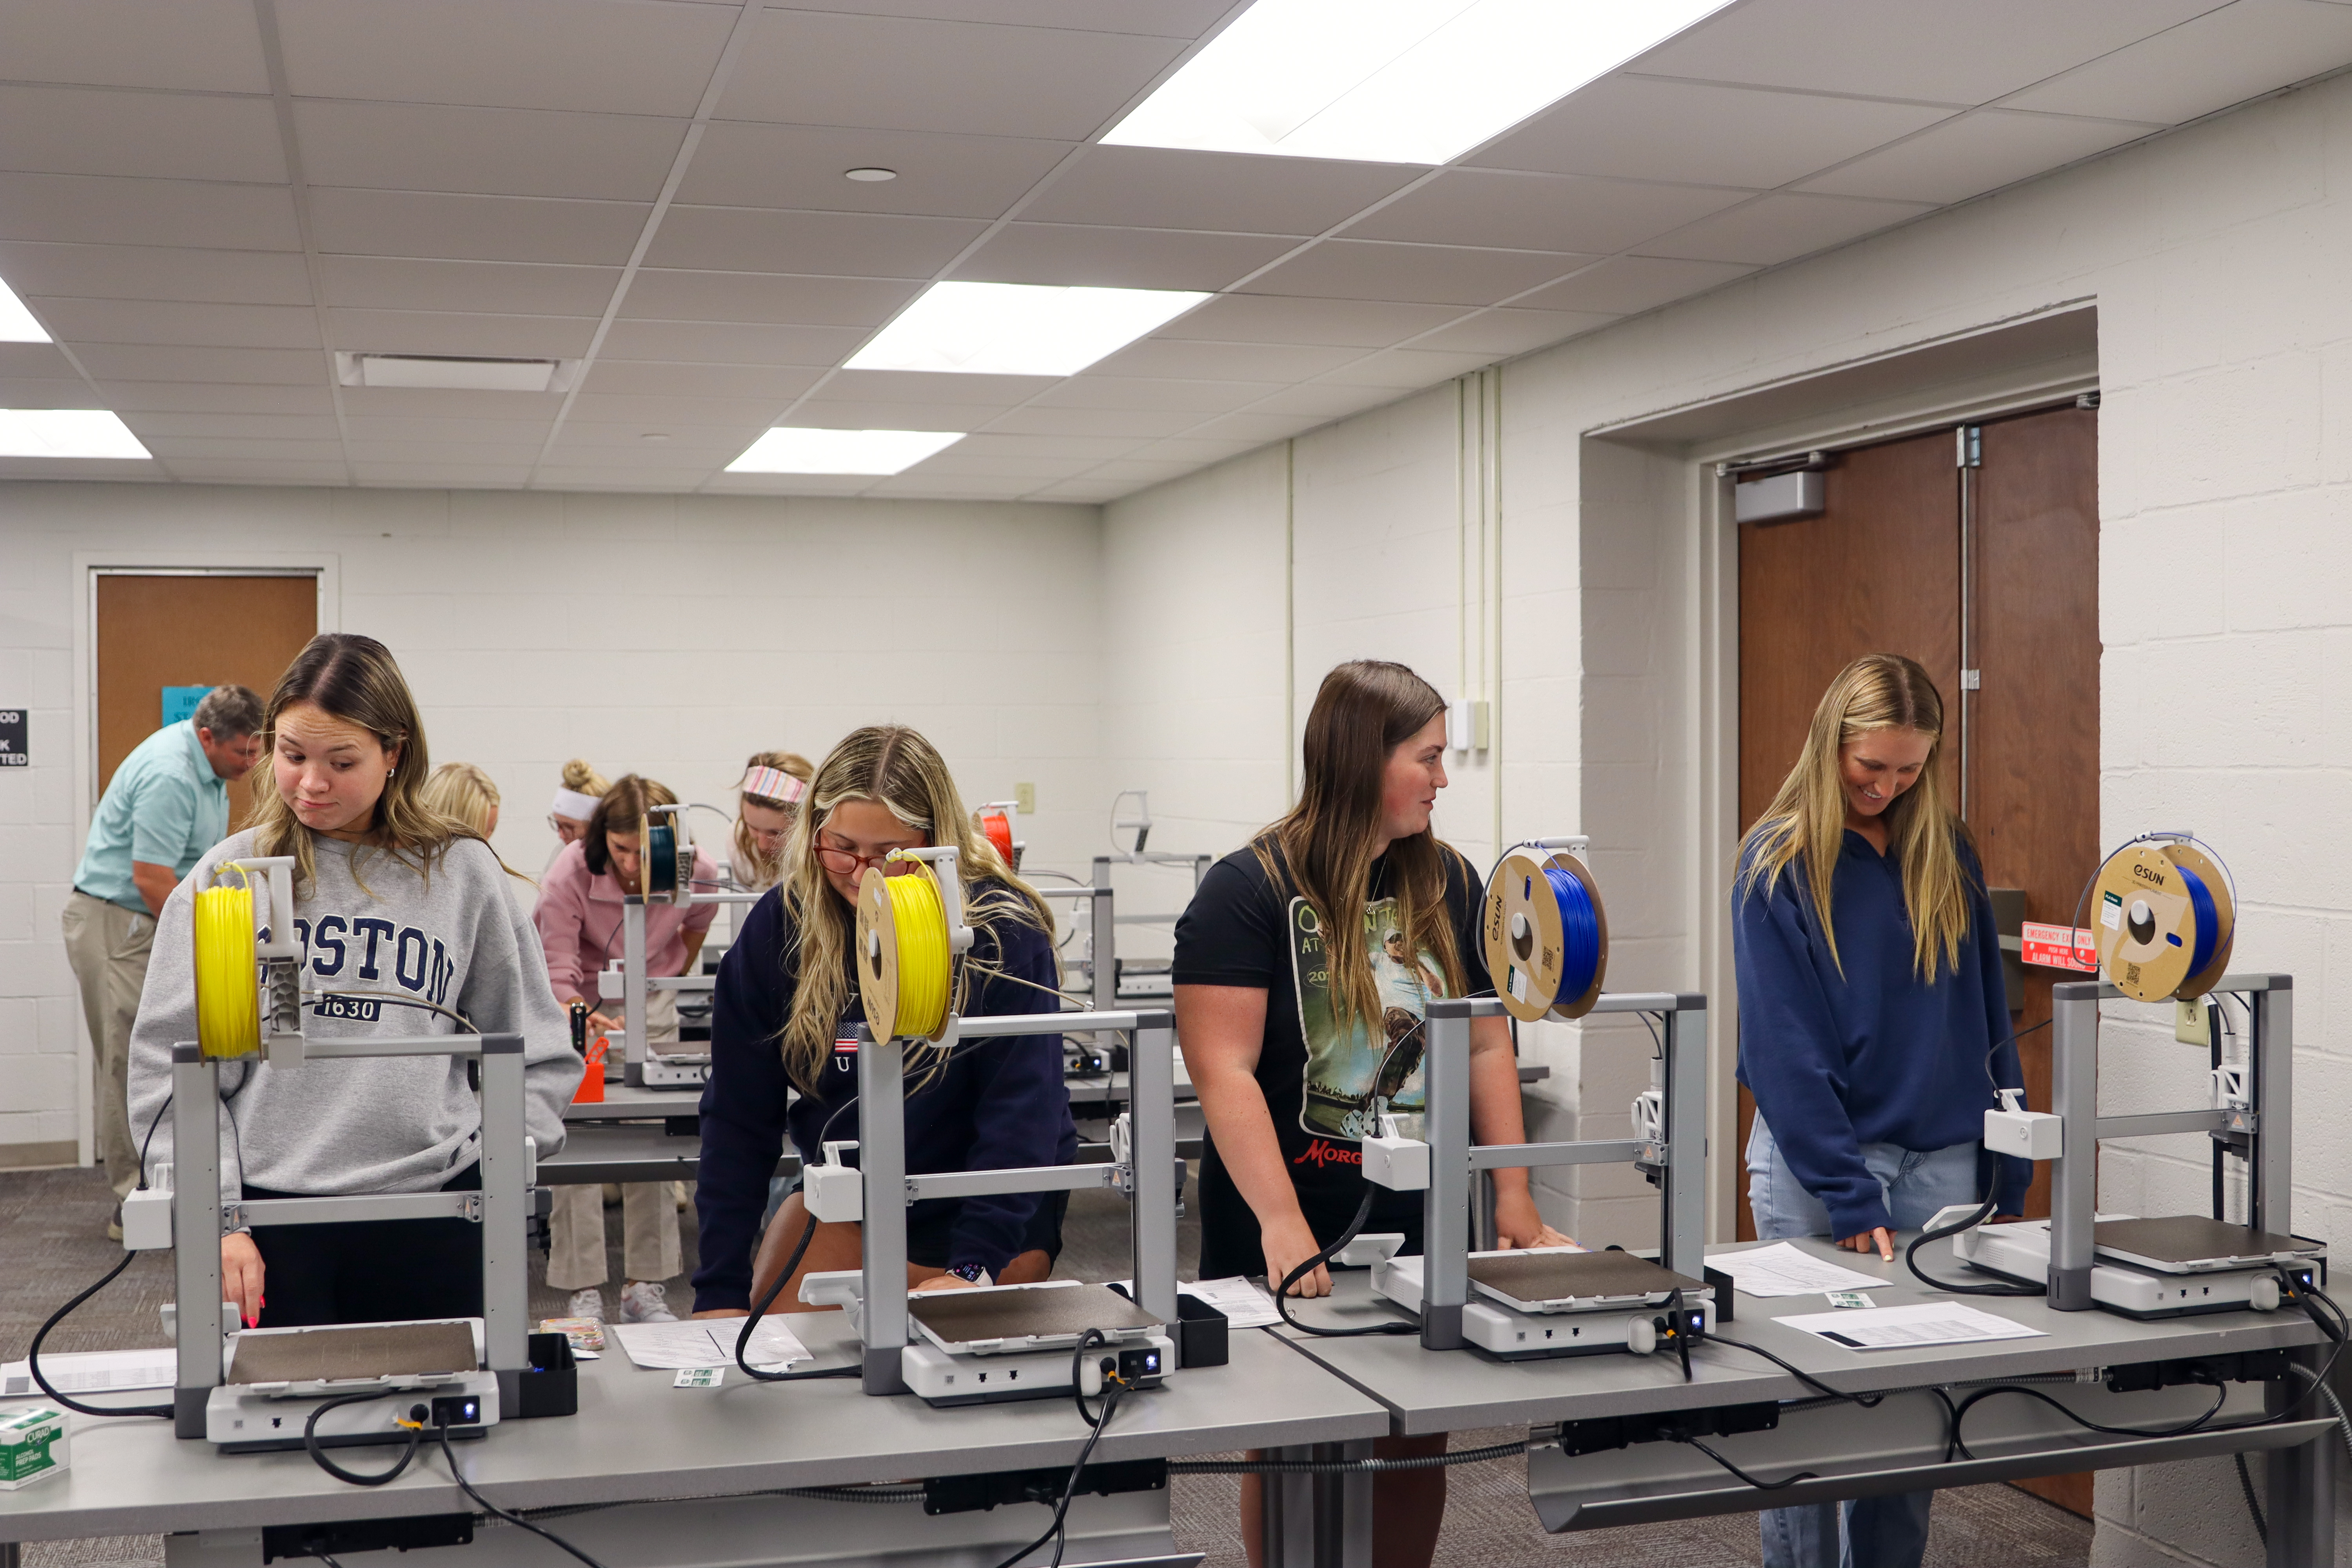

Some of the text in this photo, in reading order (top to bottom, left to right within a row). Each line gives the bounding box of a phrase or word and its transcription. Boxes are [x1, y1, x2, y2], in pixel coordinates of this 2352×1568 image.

[1302, 937, 1319, 954] AT
[2027, 928, 2091, 946] EMERGENCY EXI ONLY
[2032, 952, 2086, 969] ALARM WILL SOUND
[325, 996, 374, 1019] 1630
[1294, 1139, 1362, 1168] MORG
[27, 1427, 49, 1443] CURAD
[16, 1449, 34, 1460] ALCOHOL
[16, 1456, 29, 1466] PREP
[29, 1452, 42, 1462] PADS
